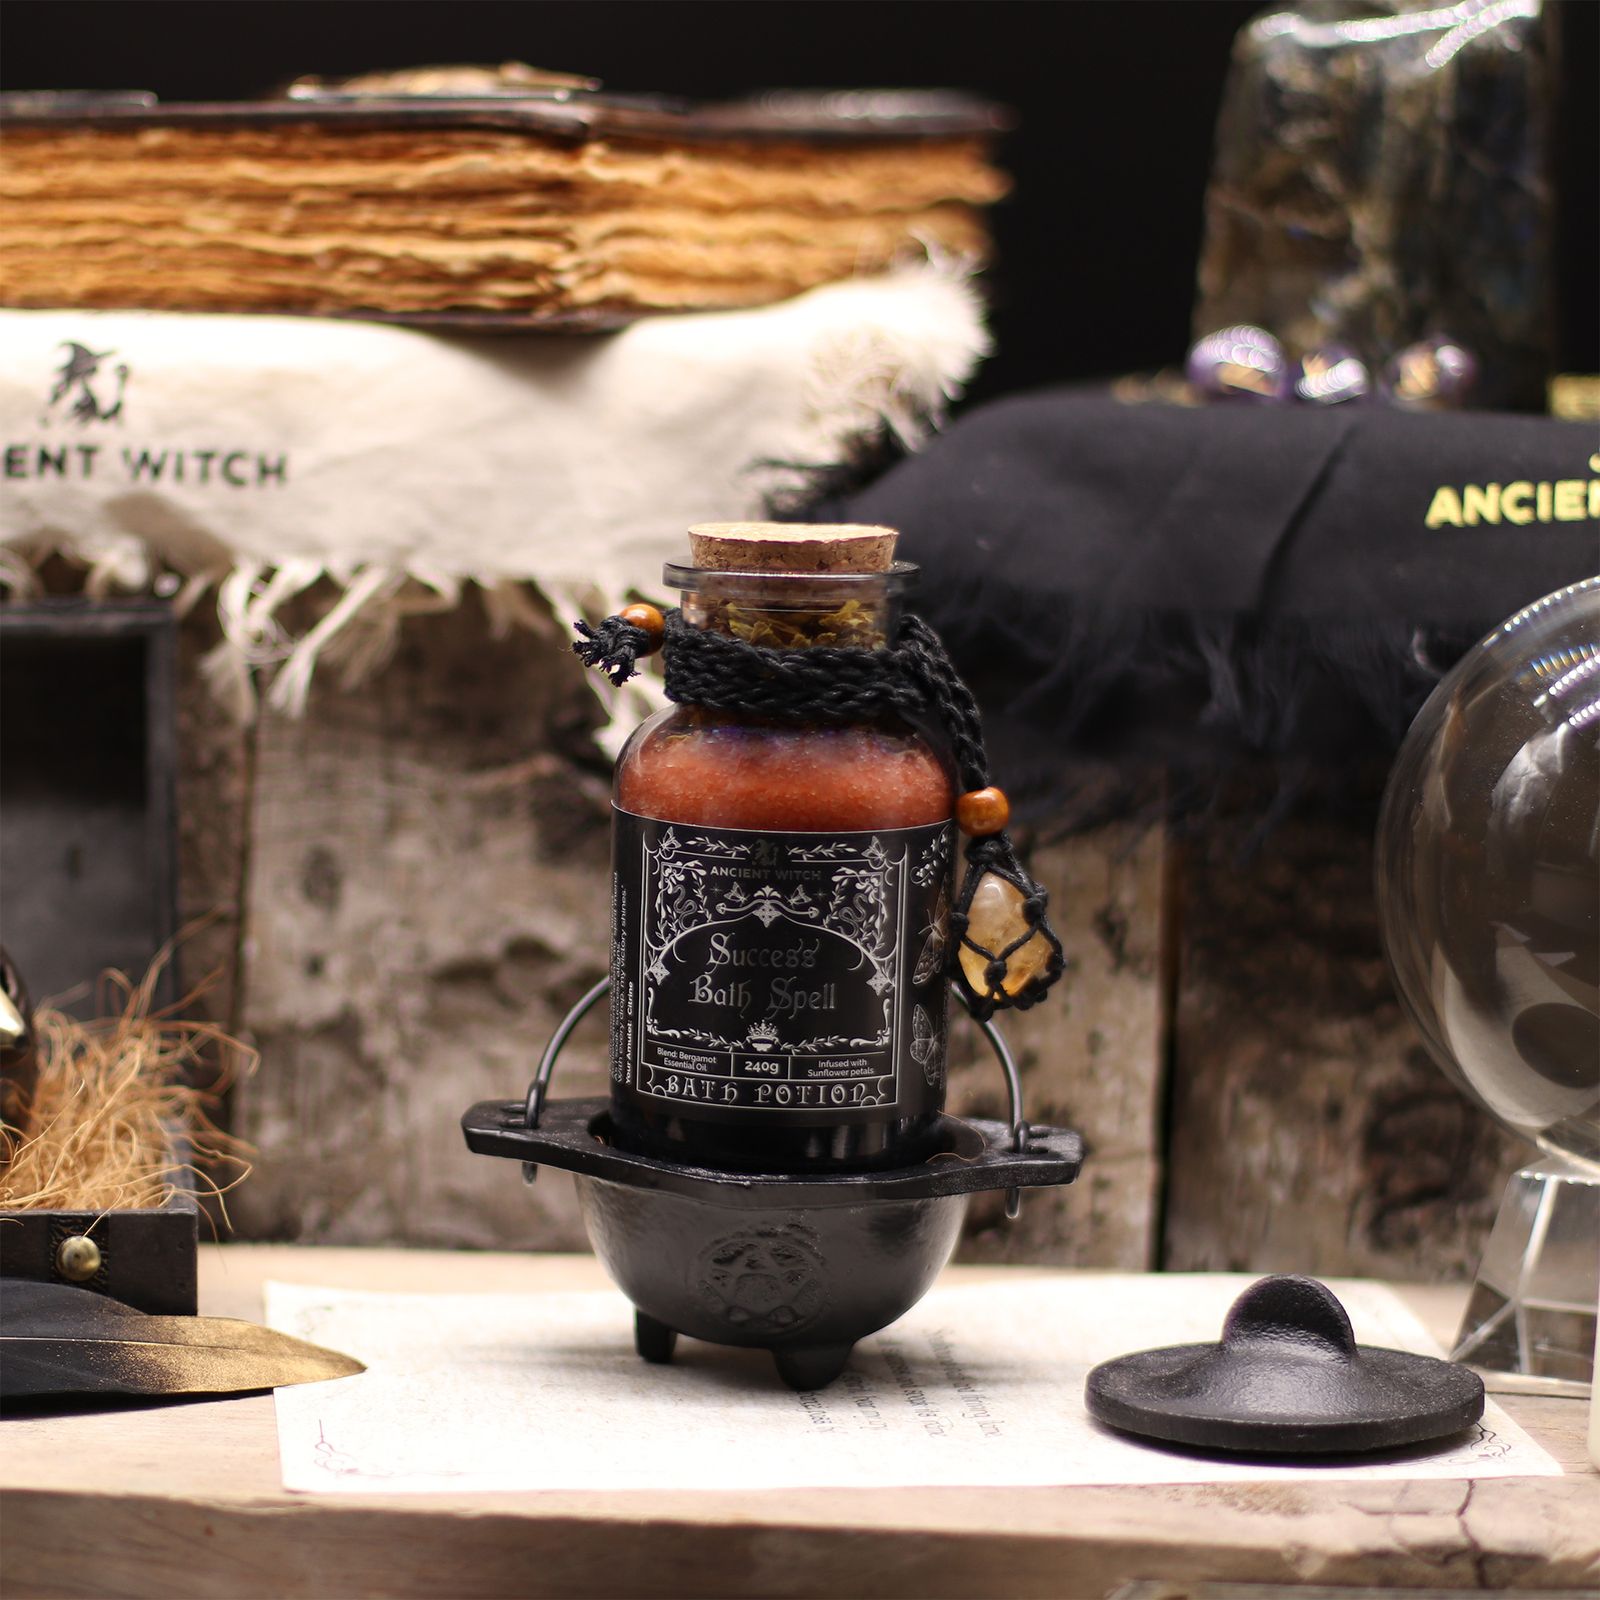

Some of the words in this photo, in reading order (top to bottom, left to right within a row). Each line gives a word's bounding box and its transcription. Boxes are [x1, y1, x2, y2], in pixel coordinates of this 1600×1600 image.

[120, 446, 288, 488] WITCH
[710, 865, 771, 879] ANCIENT
[775, 869, 822, 881] WITCH
[704, 932, 820, 975] Success
[687, 974, 752, 1019] Bath
[764, 976, 836, 1020] Spell
[656, 1046, 678, 1058] Blend:
[678, 1050, 717, 1066] Bergamot
[818, 1058, 850, 1068] Infused
[850, 1057, 868, 1067] with
[663, 1057, 695, 1069] Essential
[695, 1061, 708, 1072] Oil
[744, 1061, 779, 1074] 240g
[807, 1067, 850, 1078] Sunflower
[850, 1066, 875, 1078] petals
